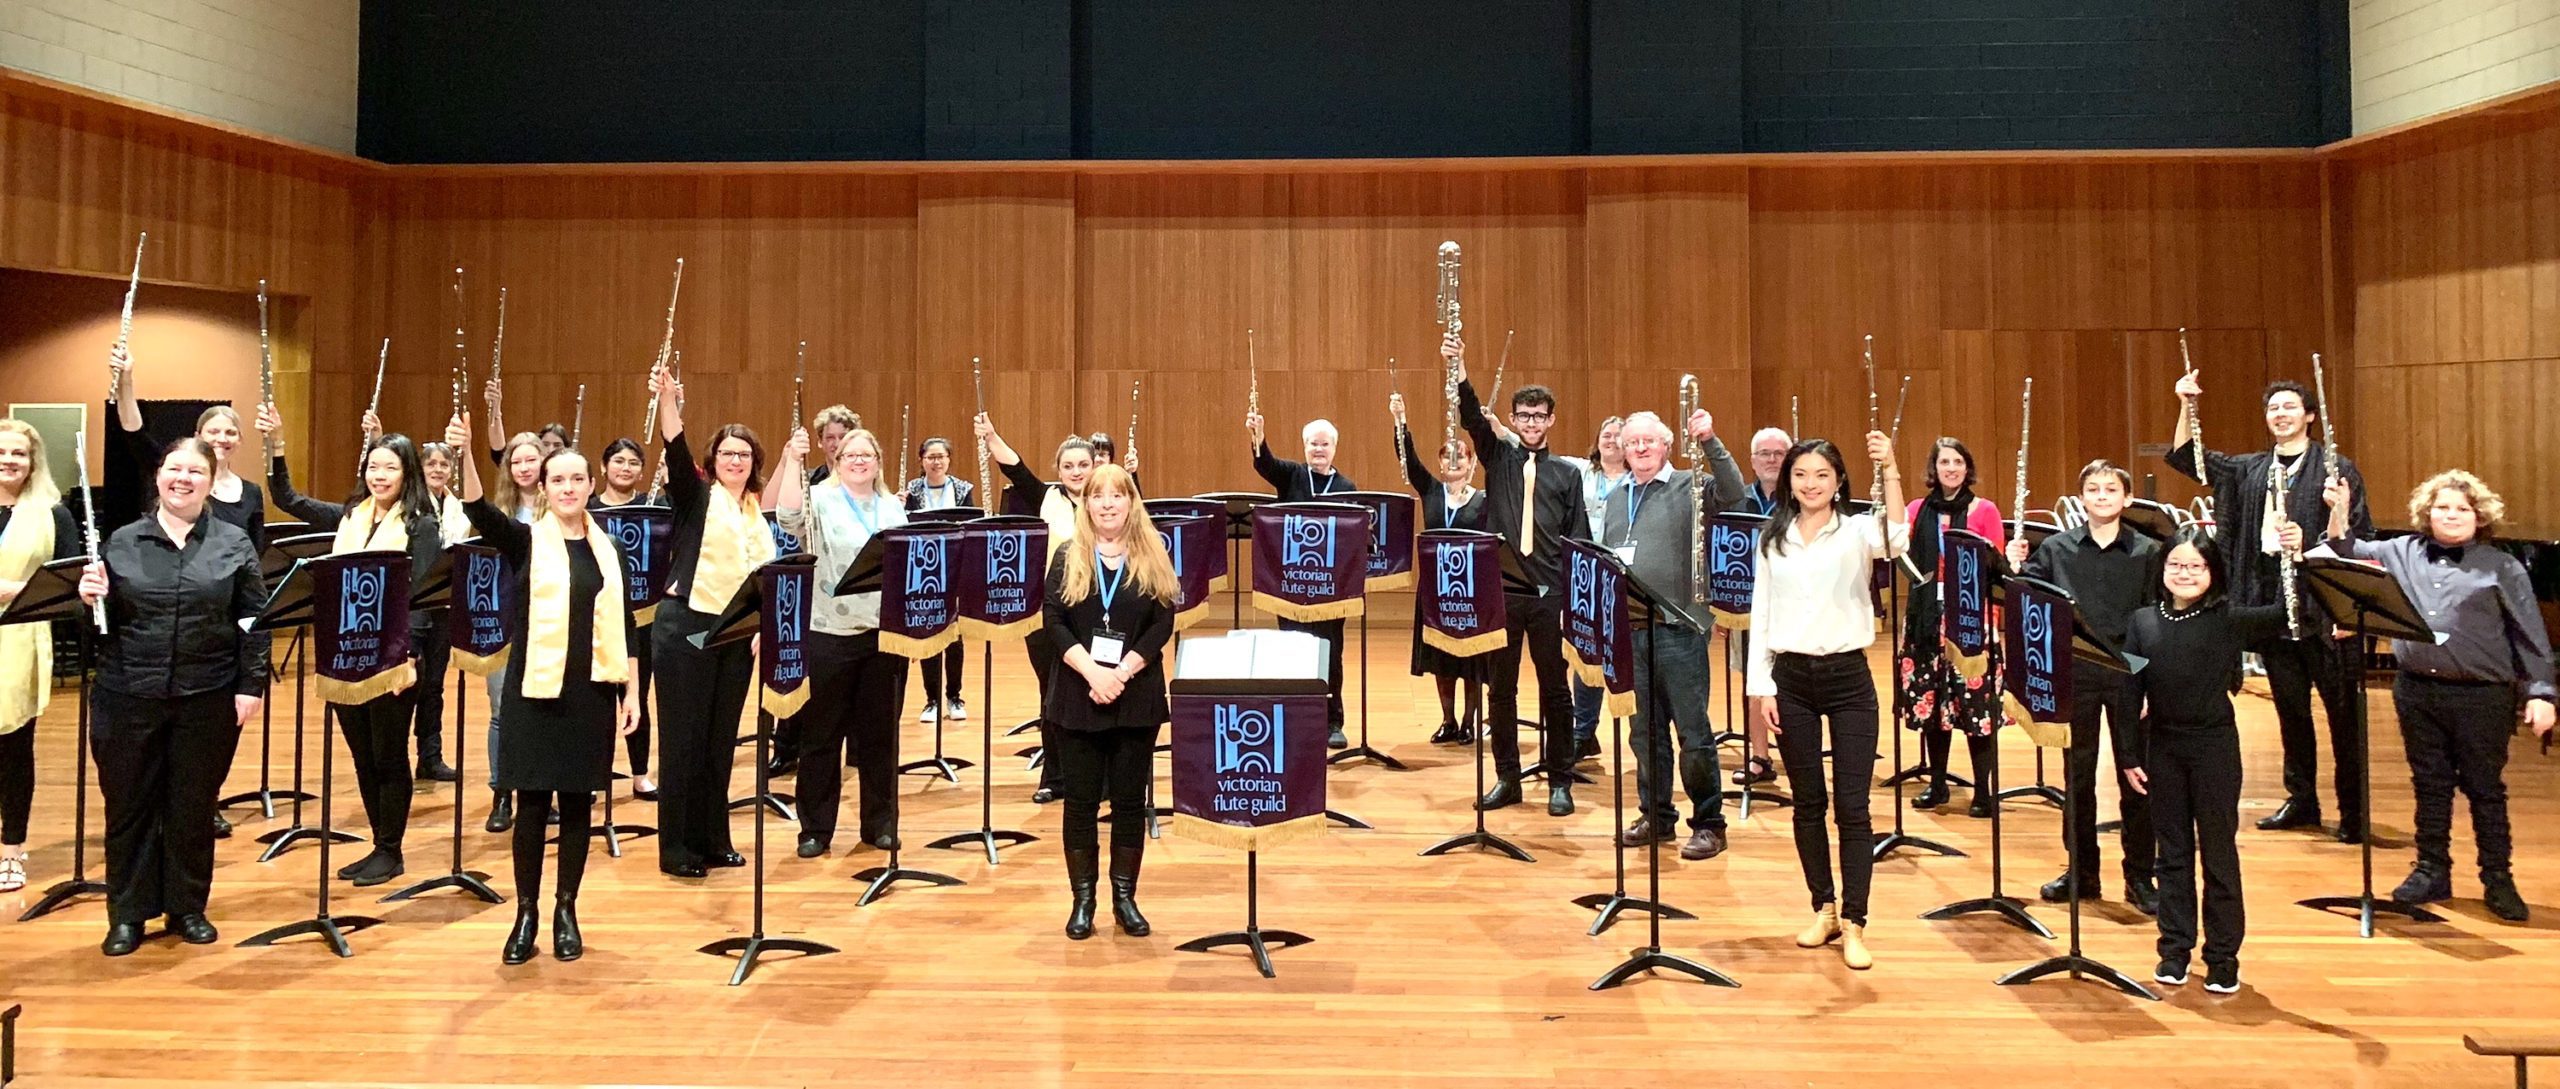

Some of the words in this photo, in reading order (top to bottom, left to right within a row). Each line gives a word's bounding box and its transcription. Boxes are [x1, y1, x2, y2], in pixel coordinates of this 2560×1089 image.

[1282, 568, 1333, 581] victorian
[630, 587, 649, 601] uild
[987, 584, 1024, 598] victorian
[1281, 580, 1306, 594] flute
[1307, 582, 1335, 598] guild
[905, 595, 945, 611] victorian
[1000, 598, 1026, 617] guild
[1438, 599, 1474, 612] victorian
[1734, 592, 1753, 606] gui
[905, 612, 926, 628] lute
[926, 609, 947, 630] guild
[1440, 612, 1457, 627] lute
[1458, 613, 1478, 631] guild
[1218, 775, 1282, 793] victorian
[1213, 793, 1249, 812] flute
[1251, 794, 1286, 816] guild
